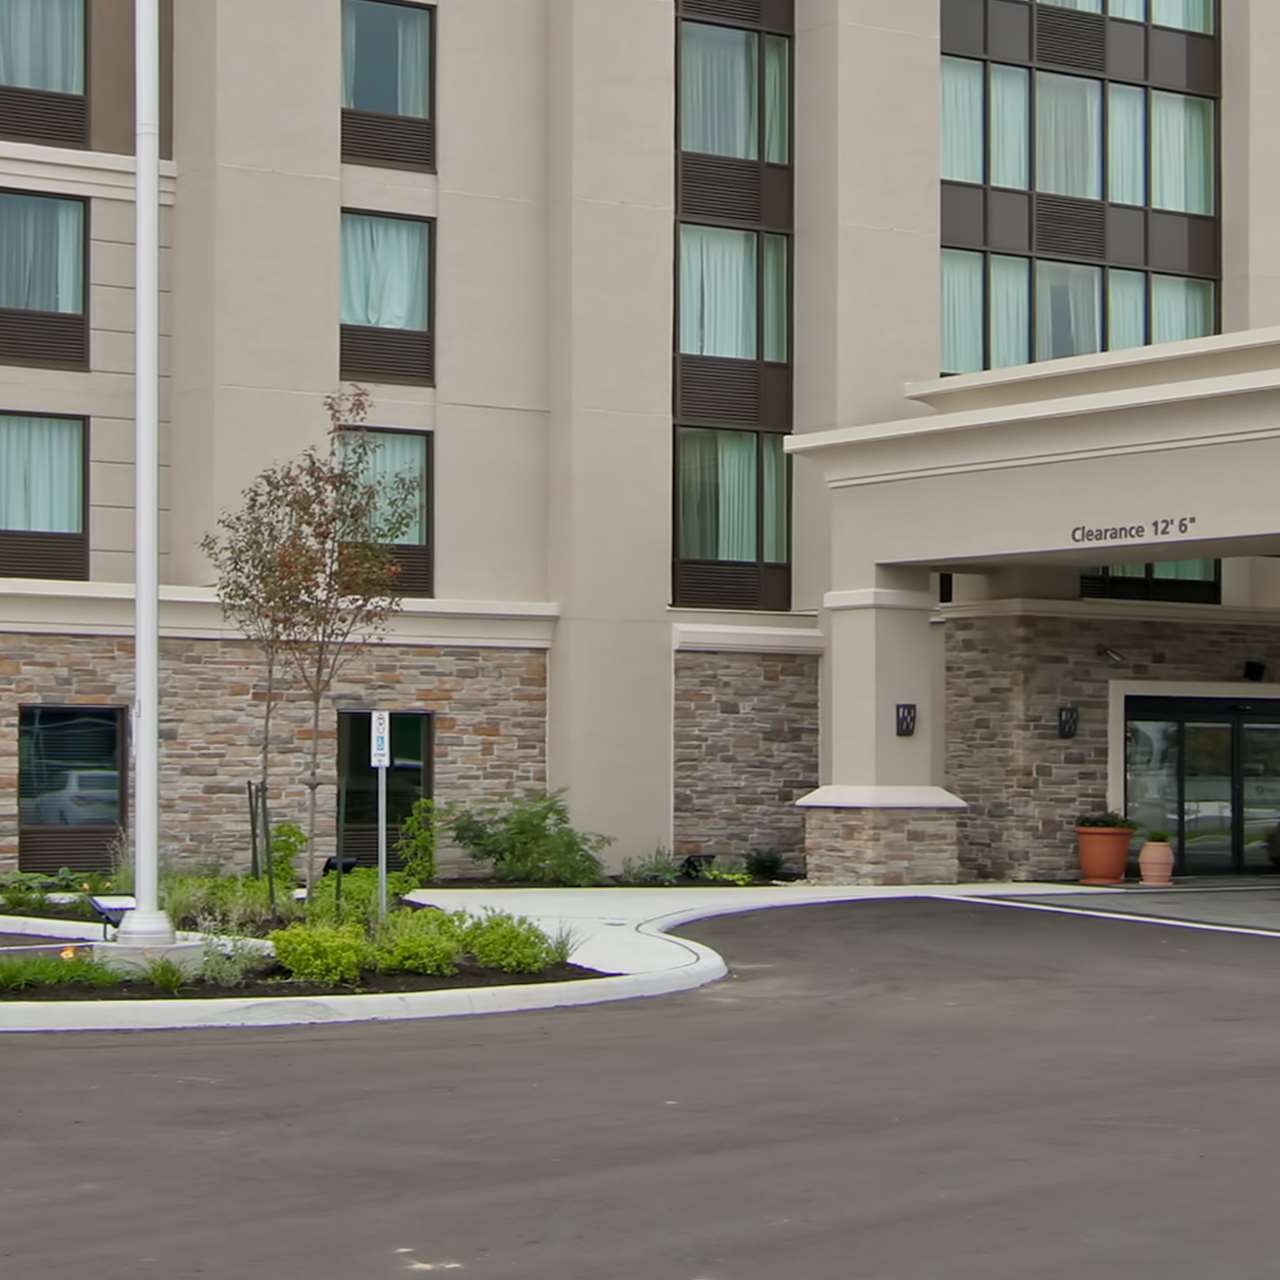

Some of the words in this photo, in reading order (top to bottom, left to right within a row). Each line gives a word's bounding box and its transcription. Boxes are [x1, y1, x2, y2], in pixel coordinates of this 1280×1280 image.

[1071, 526, 1145, 543] Clearance
[1152, 519, 1174, 536] 12'
[1178, 516, 1196, 534] 6"
